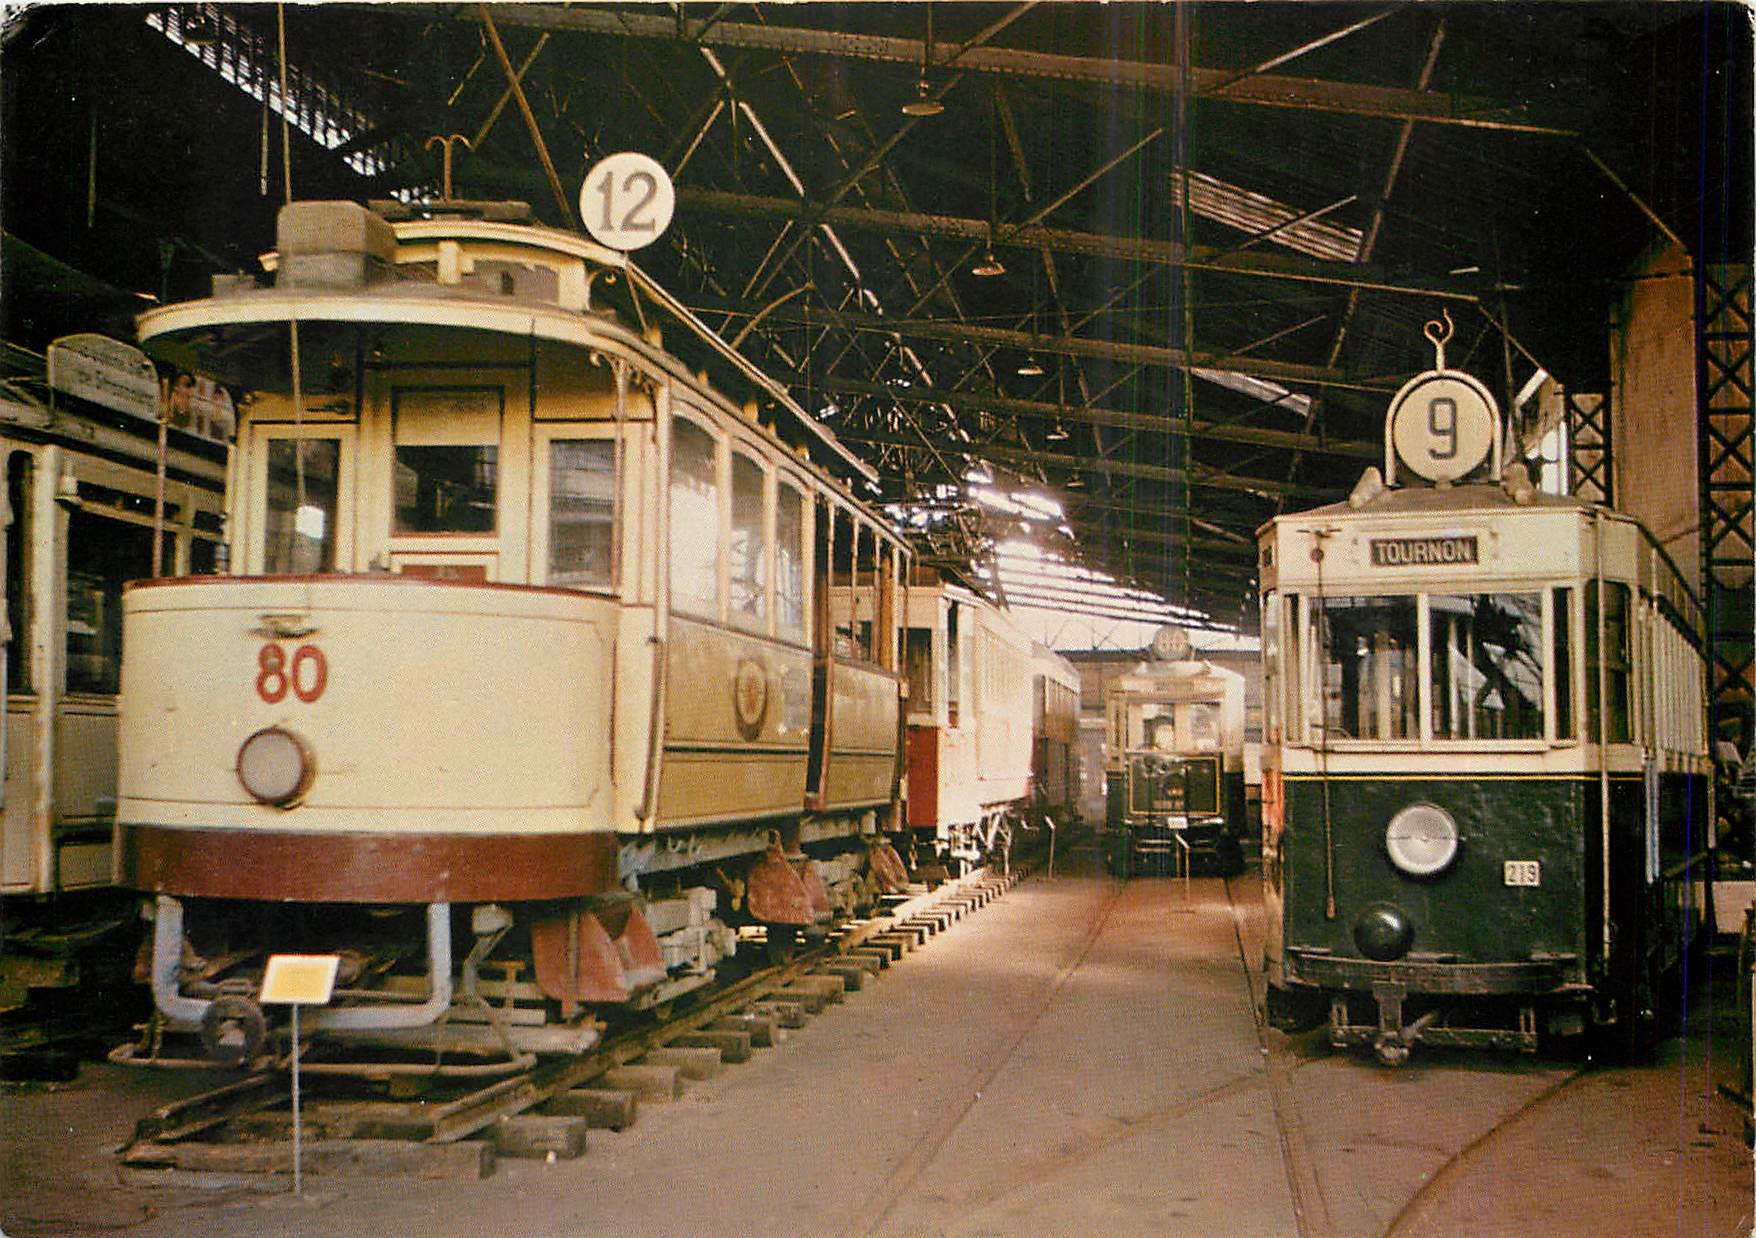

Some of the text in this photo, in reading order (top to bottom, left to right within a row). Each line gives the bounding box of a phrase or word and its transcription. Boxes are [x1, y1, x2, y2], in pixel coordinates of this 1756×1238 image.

[598, 171, 656, 233] 12
[1428, 397, 1457, 460] 9
[1376, 540, 1471, 563] TOURNON
[256, 643, 327, 704] 80
